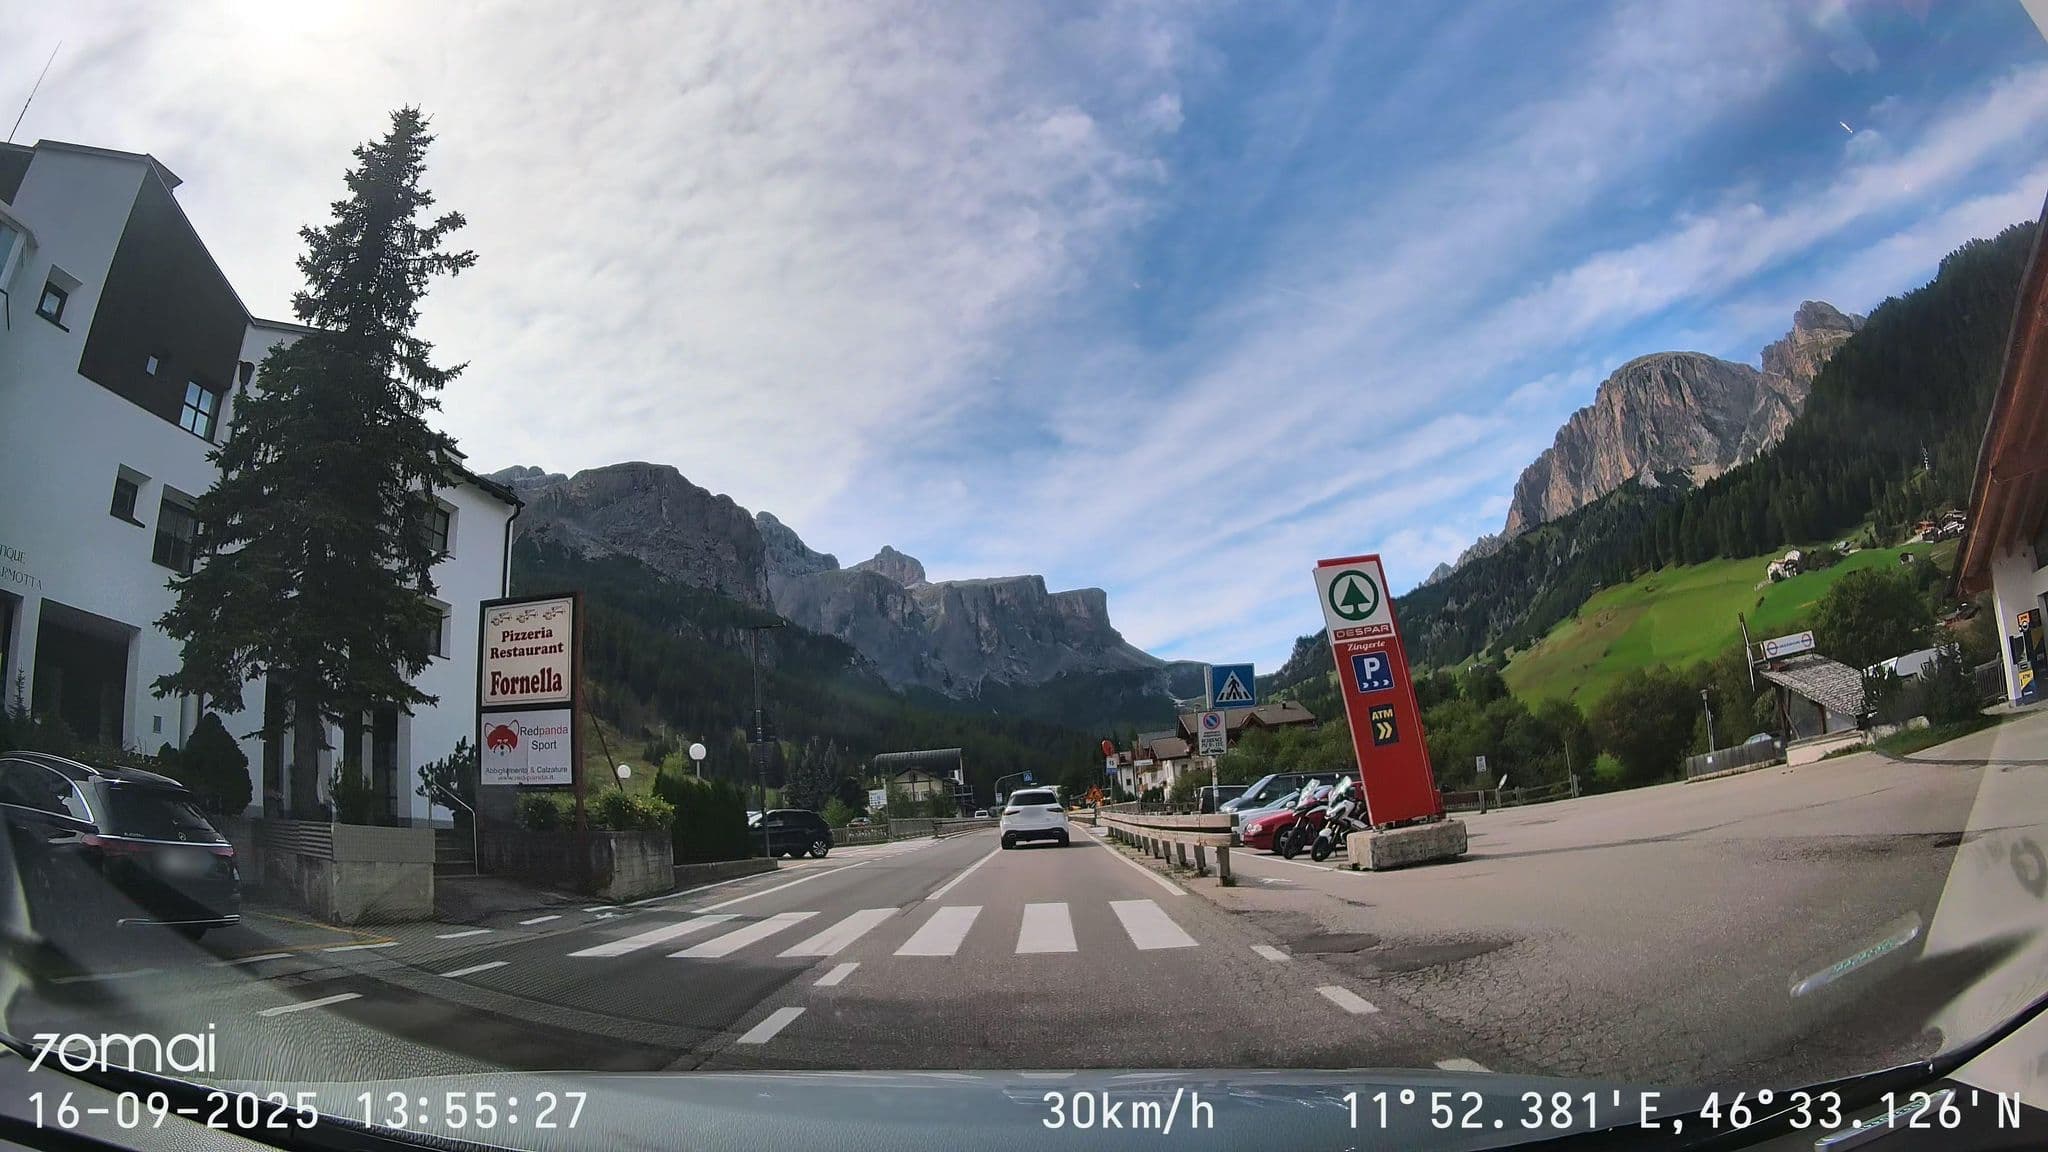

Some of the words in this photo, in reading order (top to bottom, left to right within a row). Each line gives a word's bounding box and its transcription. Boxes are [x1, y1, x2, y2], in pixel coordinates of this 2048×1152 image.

[501, 626, 553, 643] Pizzeria
[1336, 625, 1389, 639] DESPAR
[490, 642, 564, 660] Restaurant
[1347, 640, 1386, 652] Zingerle
[1363, 657, 1381, 680] P
[490, 667, 562, 696] Fornella
[1372, 708, 1394, 721] ATM
[520, 725, 569, 737] Redpanda
[531, 739, 557, 752] Sport
